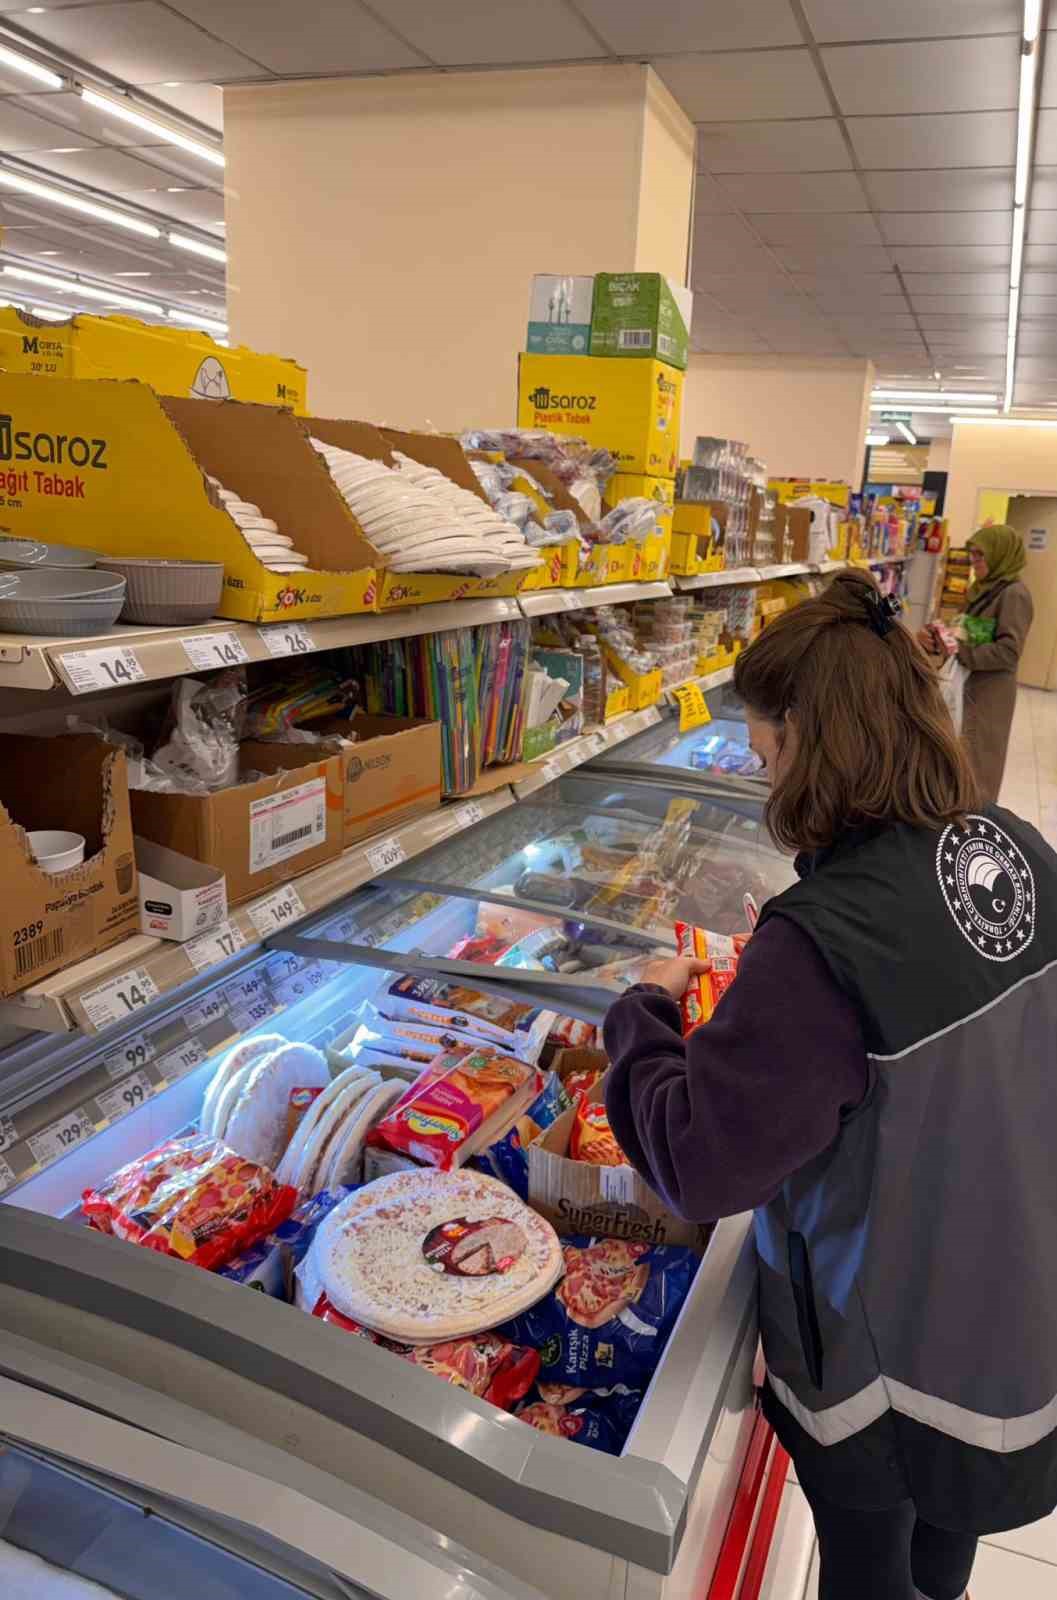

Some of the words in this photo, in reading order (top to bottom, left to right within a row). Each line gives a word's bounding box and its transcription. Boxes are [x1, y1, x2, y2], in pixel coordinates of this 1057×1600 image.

[550, 395, 597, 410] saroz
[15, 431, 108, 470] saroz
[33, 470, 86, 499] Tabak
[213, 643, 239, 664] 14
[100, 659, 132, 684] 14
[13, 920, 44, 946] 2389
[215, 934, 236, 956] 17
[117, 986, 146, 1012] 14
[125, 1045, 145, 1067] 99
[122, 1086, 144, 1108] 99
[56, 1123, 81, 1147] 129
[557, 1197, 667, 1242] SuperFresh
